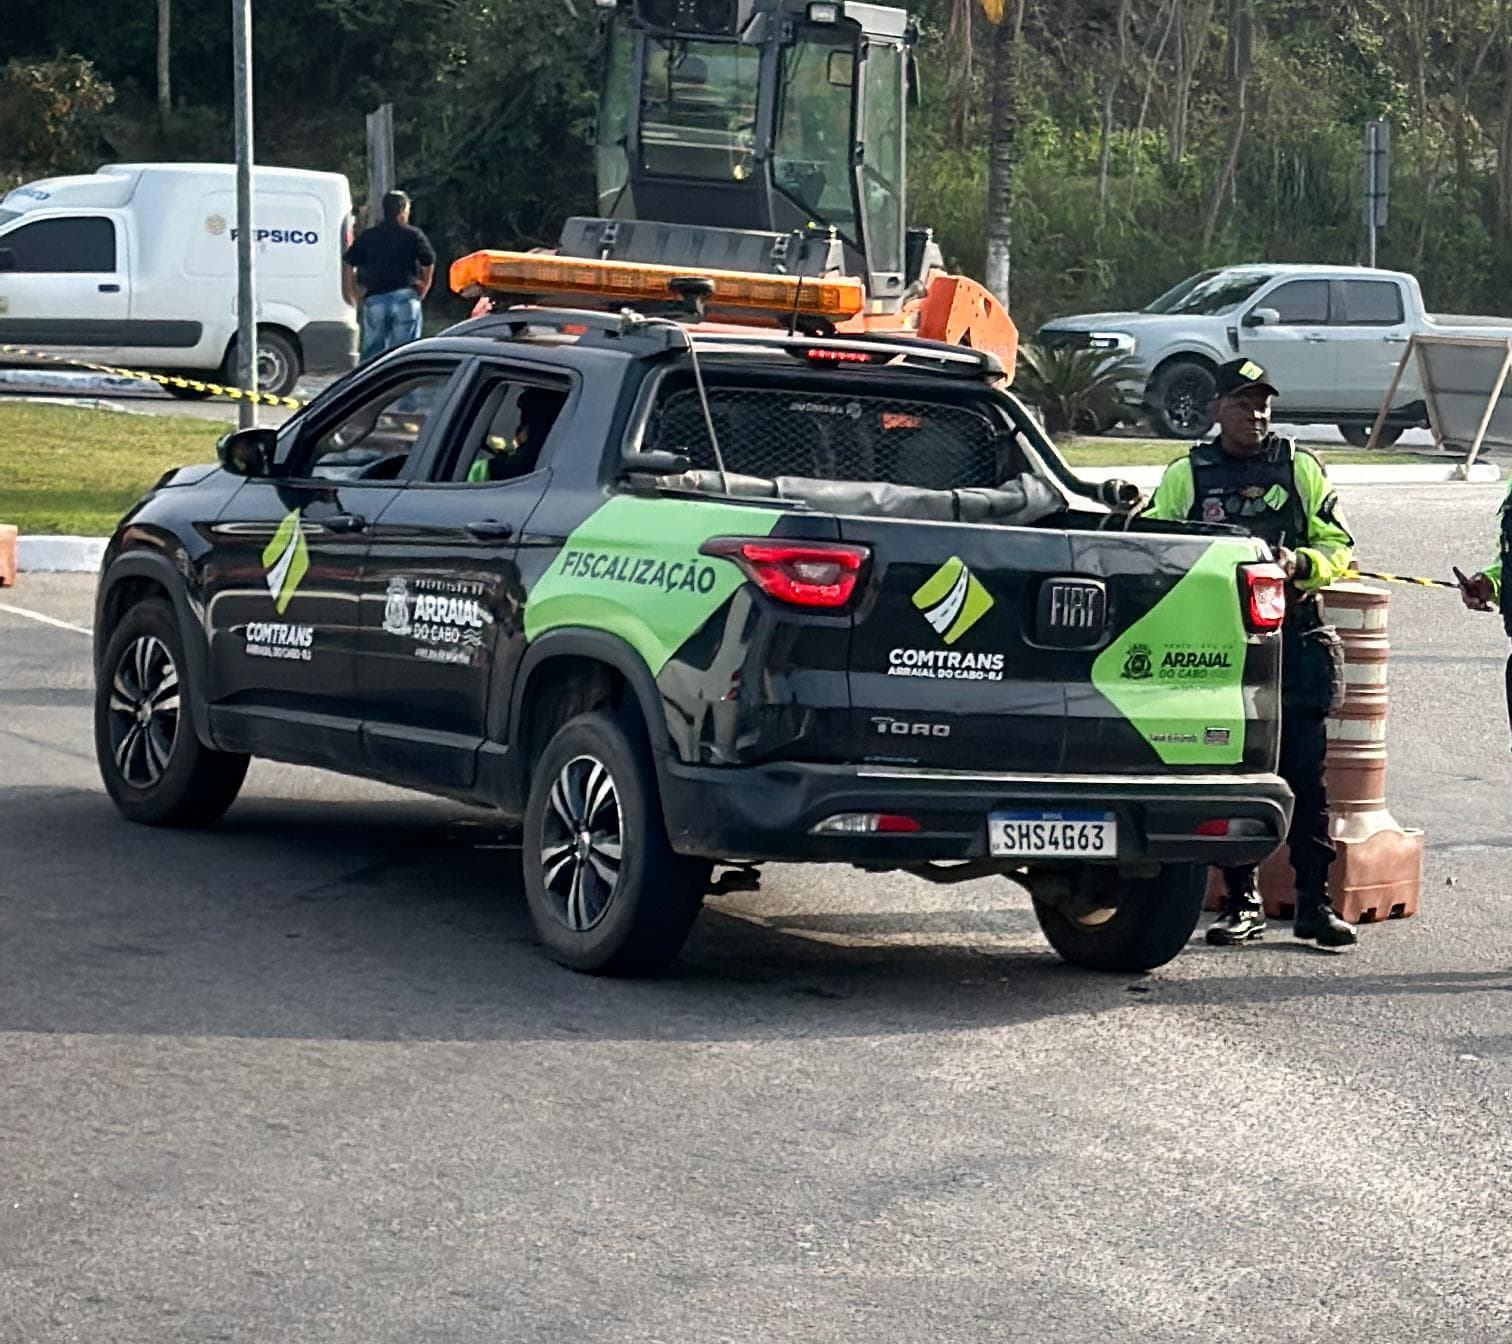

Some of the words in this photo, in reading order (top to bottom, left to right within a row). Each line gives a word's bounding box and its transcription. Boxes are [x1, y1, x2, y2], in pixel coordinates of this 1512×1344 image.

[230, 229, 319, 245] PPSICO
[560, 551, 716, 594] FISCALIZAÇÃO
[413, 594, 483, 628] ARRAIAL
[1051, 586, 1098, 627] FIAT
[246, 622, 313, 647] COMTRANS
[888, 648, 1004, 670] COMTRANS
[1160, 651, 1232, 668] ARRAIAL
[887, 666, 935, 678] ARRAIAL
[870, 716, 950, 737] TORO
[1003, 823, 1104, 850] SHS4G63
